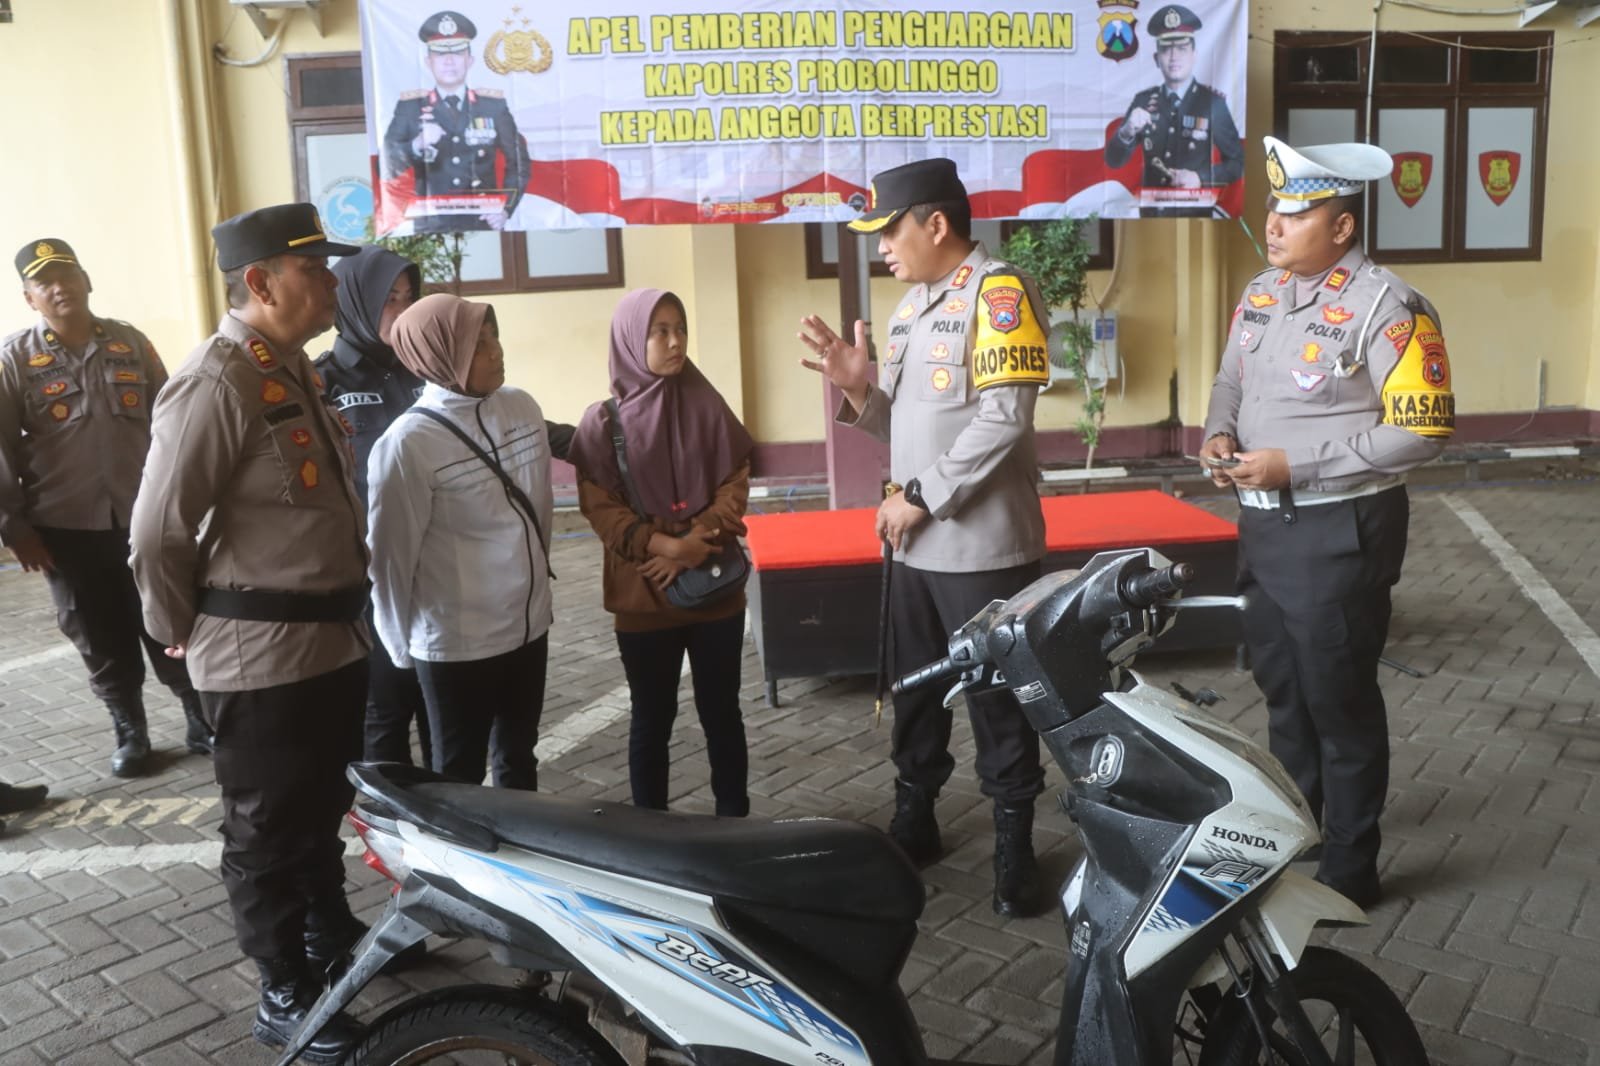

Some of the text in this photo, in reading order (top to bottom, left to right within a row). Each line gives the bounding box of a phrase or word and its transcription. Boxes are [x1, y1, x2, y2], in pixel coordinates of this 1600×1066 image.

[567, 11, 1074, 56] APEL PEMBERIAN PENGHARGAAN
[644, 59, 998, 99] KAPOLRES PROBOLINGGO
[600, 104, 1048, 146] KEPADA ANGGOTA BERPRESTASI
[931, 320, 966, 335] POLRI
[1304, 322, 1347, 343] POLRI
[974, 345, 1046, 378] KAOPSRES
[340, 393, 372, 407] VITA
[1211, 826, 1279, 852] HONDA
[1200, 859, 1265, 885] FI
